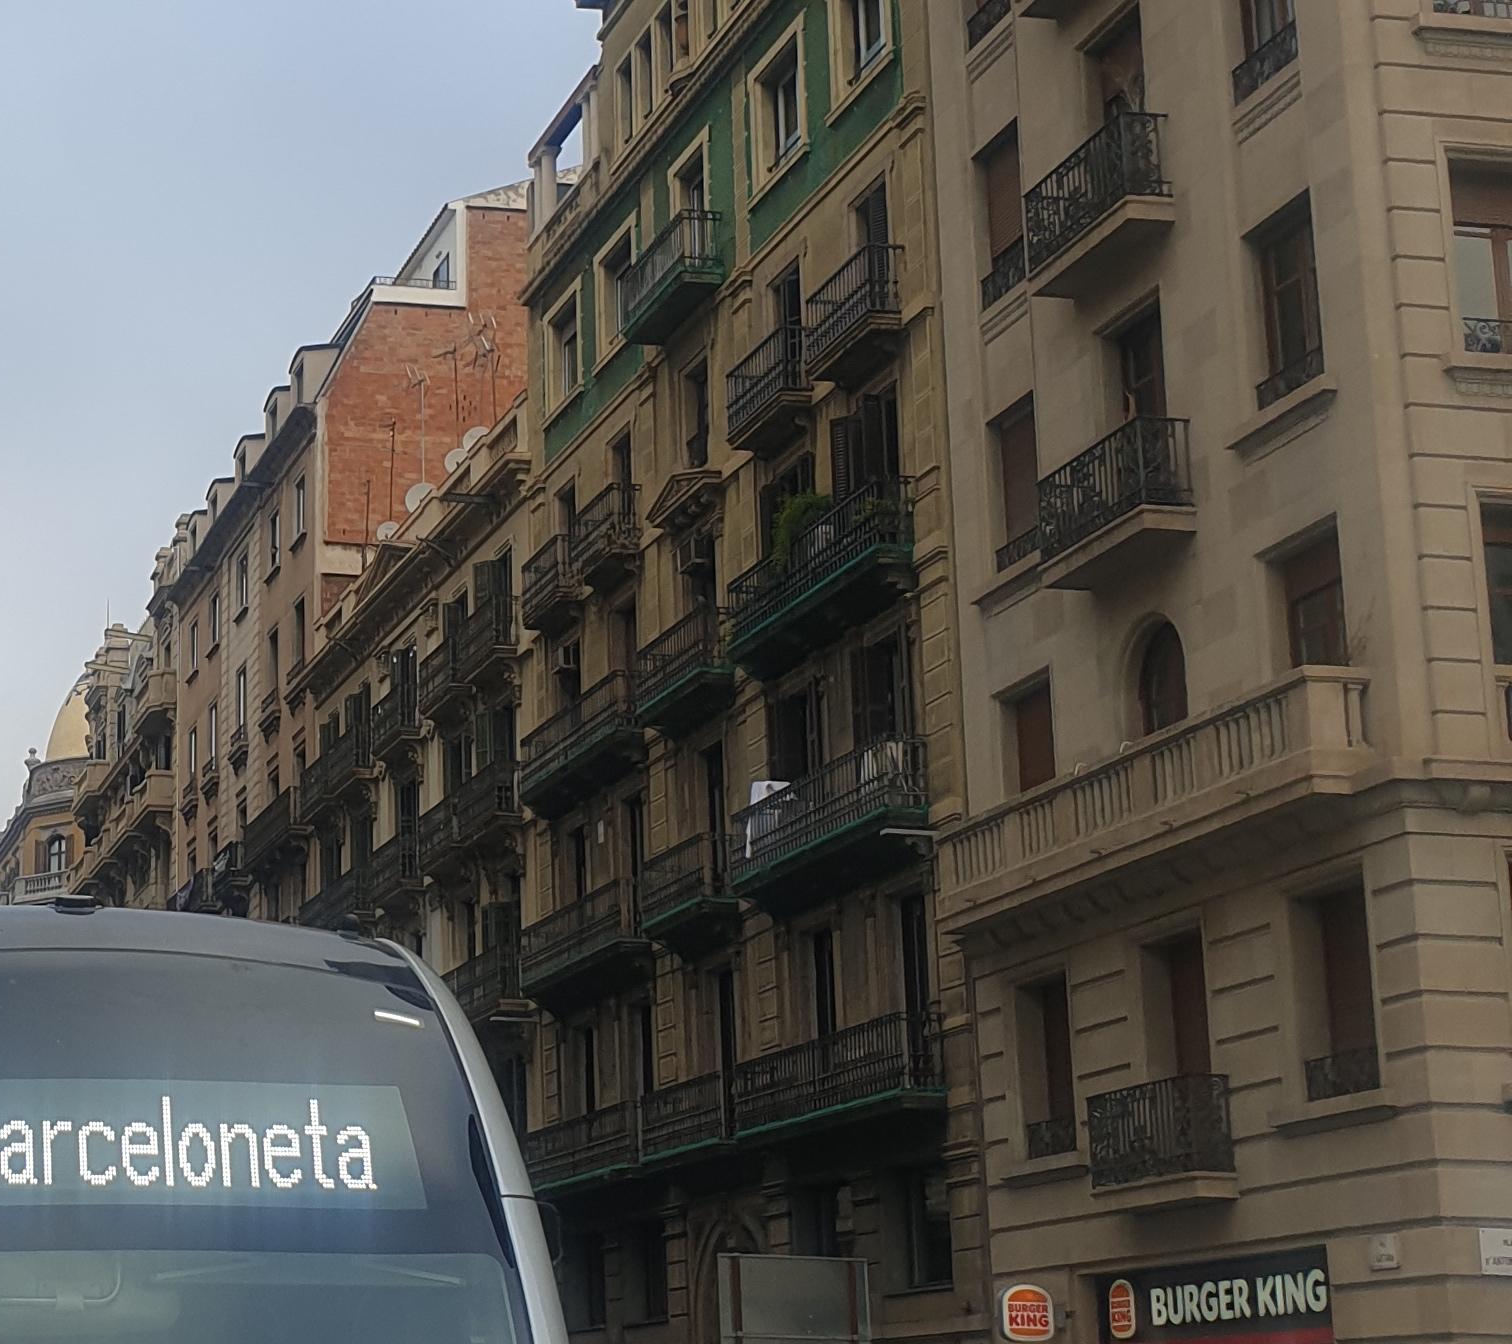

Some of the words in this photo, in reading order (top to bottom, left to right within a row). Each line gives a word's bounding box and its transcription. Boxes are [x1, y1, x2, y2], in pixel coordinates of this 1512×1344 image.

[1150, 1279, 1252, 1327] BURGER
[1256, 1268, 1327, 1318] KING
[1008, 1303, 1048, 1313] BURGER
[1009, 1313, 1049, 1328] KING
